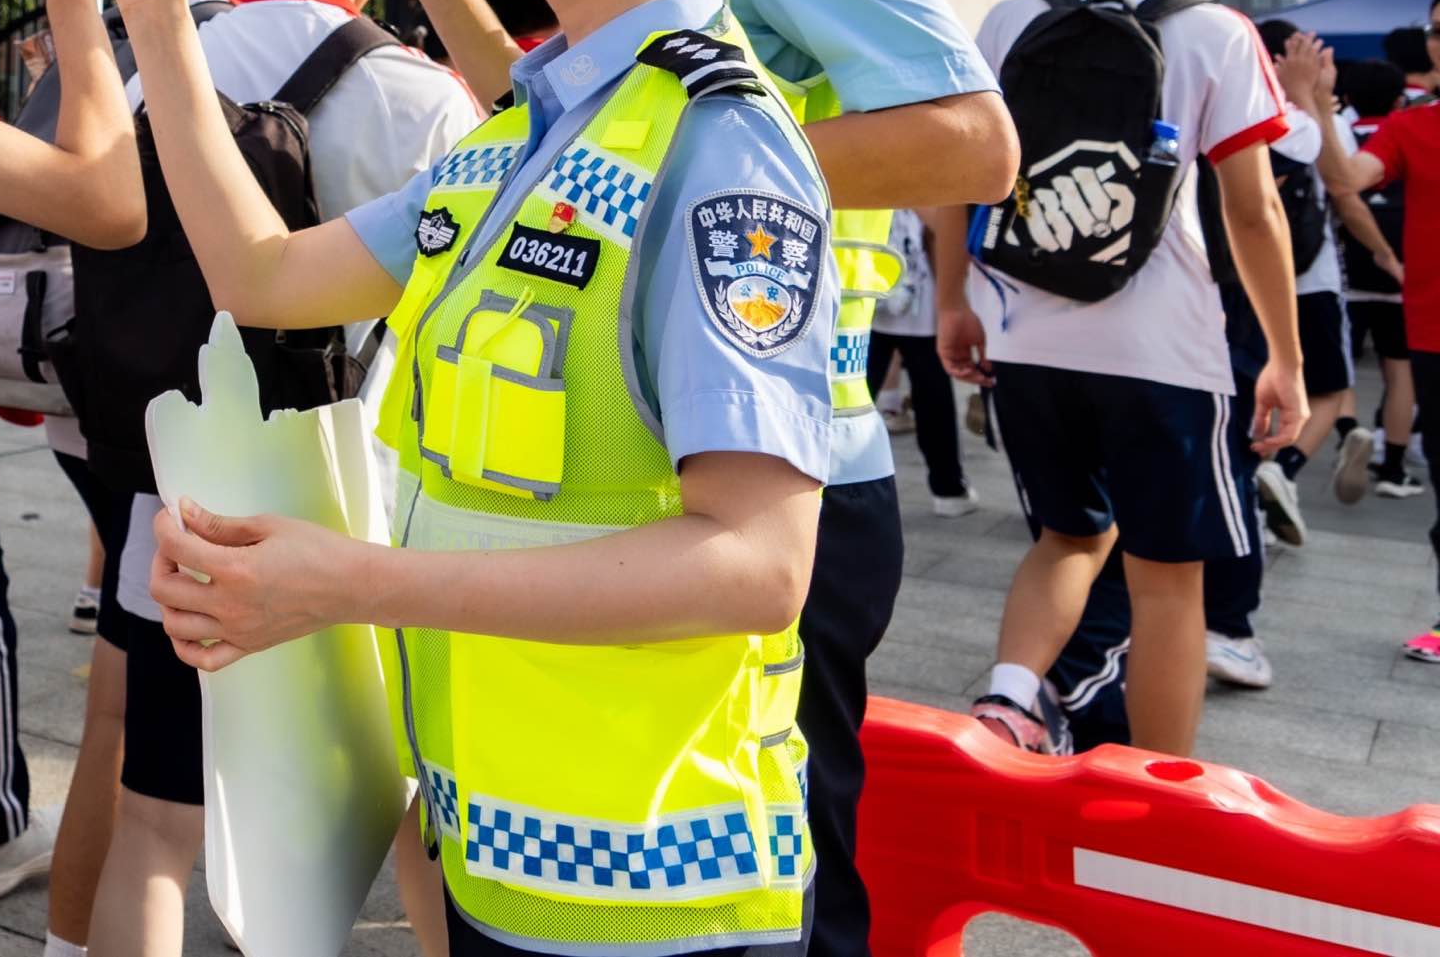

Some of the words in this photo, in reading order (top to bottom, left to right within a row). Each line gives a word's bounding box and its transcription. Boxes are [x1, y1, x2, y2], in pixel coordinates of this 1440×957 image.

[697, 198, 817, 243] 中华人民共和国
[509, 236, 587, 277] 036211
[735, 261, 787, 280] POLICE
